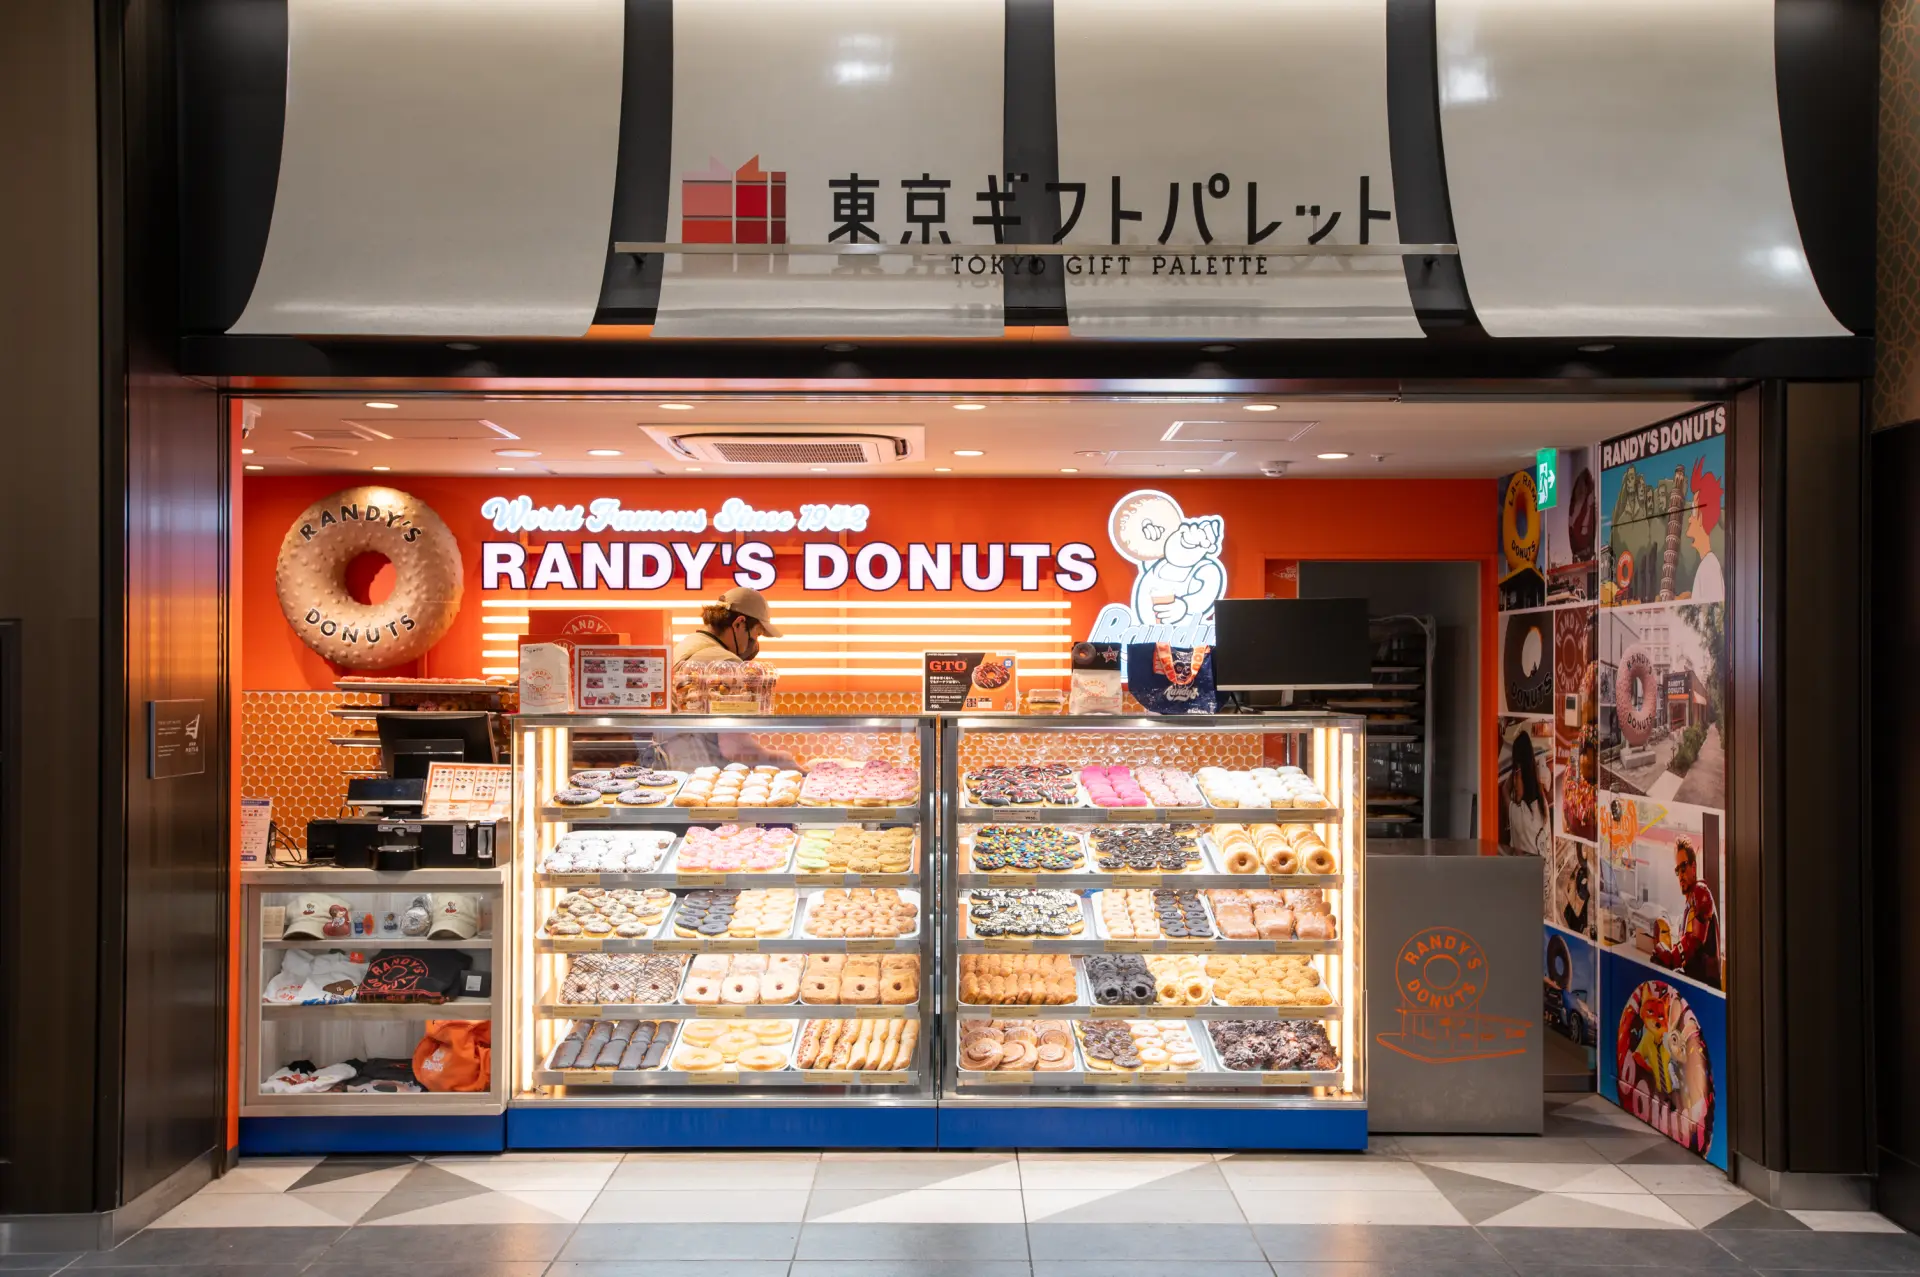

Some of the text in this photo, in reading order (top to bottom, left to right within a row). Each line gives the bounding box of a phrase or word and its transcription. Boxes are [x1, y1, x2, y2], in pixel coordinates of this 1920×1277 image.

[828, 173, 1391, 244] 東京ギフトパレット
[951, 256, 1267, 275] TOKYO GIFT PALETTE
[1603, 406, 1726, 469] RANDY'S DONUTS
[300, 504, 421, 543] RANDY'S
[482, 495, 585, 533] World
[586, 498, 707, 533] Famous
[713, 498, 798, 533] Since
[481, 541, 1098, 592] RANDY'S DONUTS
[1511, 539, 1536, 562] DONUTS
[305, 608, 416, 644] DONUTS
[929, 660, 967, 671] GTO
[1557, 662, 1582, 691] DONUTS
[1510, 672, 1553, 709] DONUTS
[1627, 712, 1652, 730] DONUTS
[371, 958, 425, 975] RANDY'S
[1404, 935, 1481, 969] RANDY'S
[1407, 979, 1476, 1009] DONUTS
